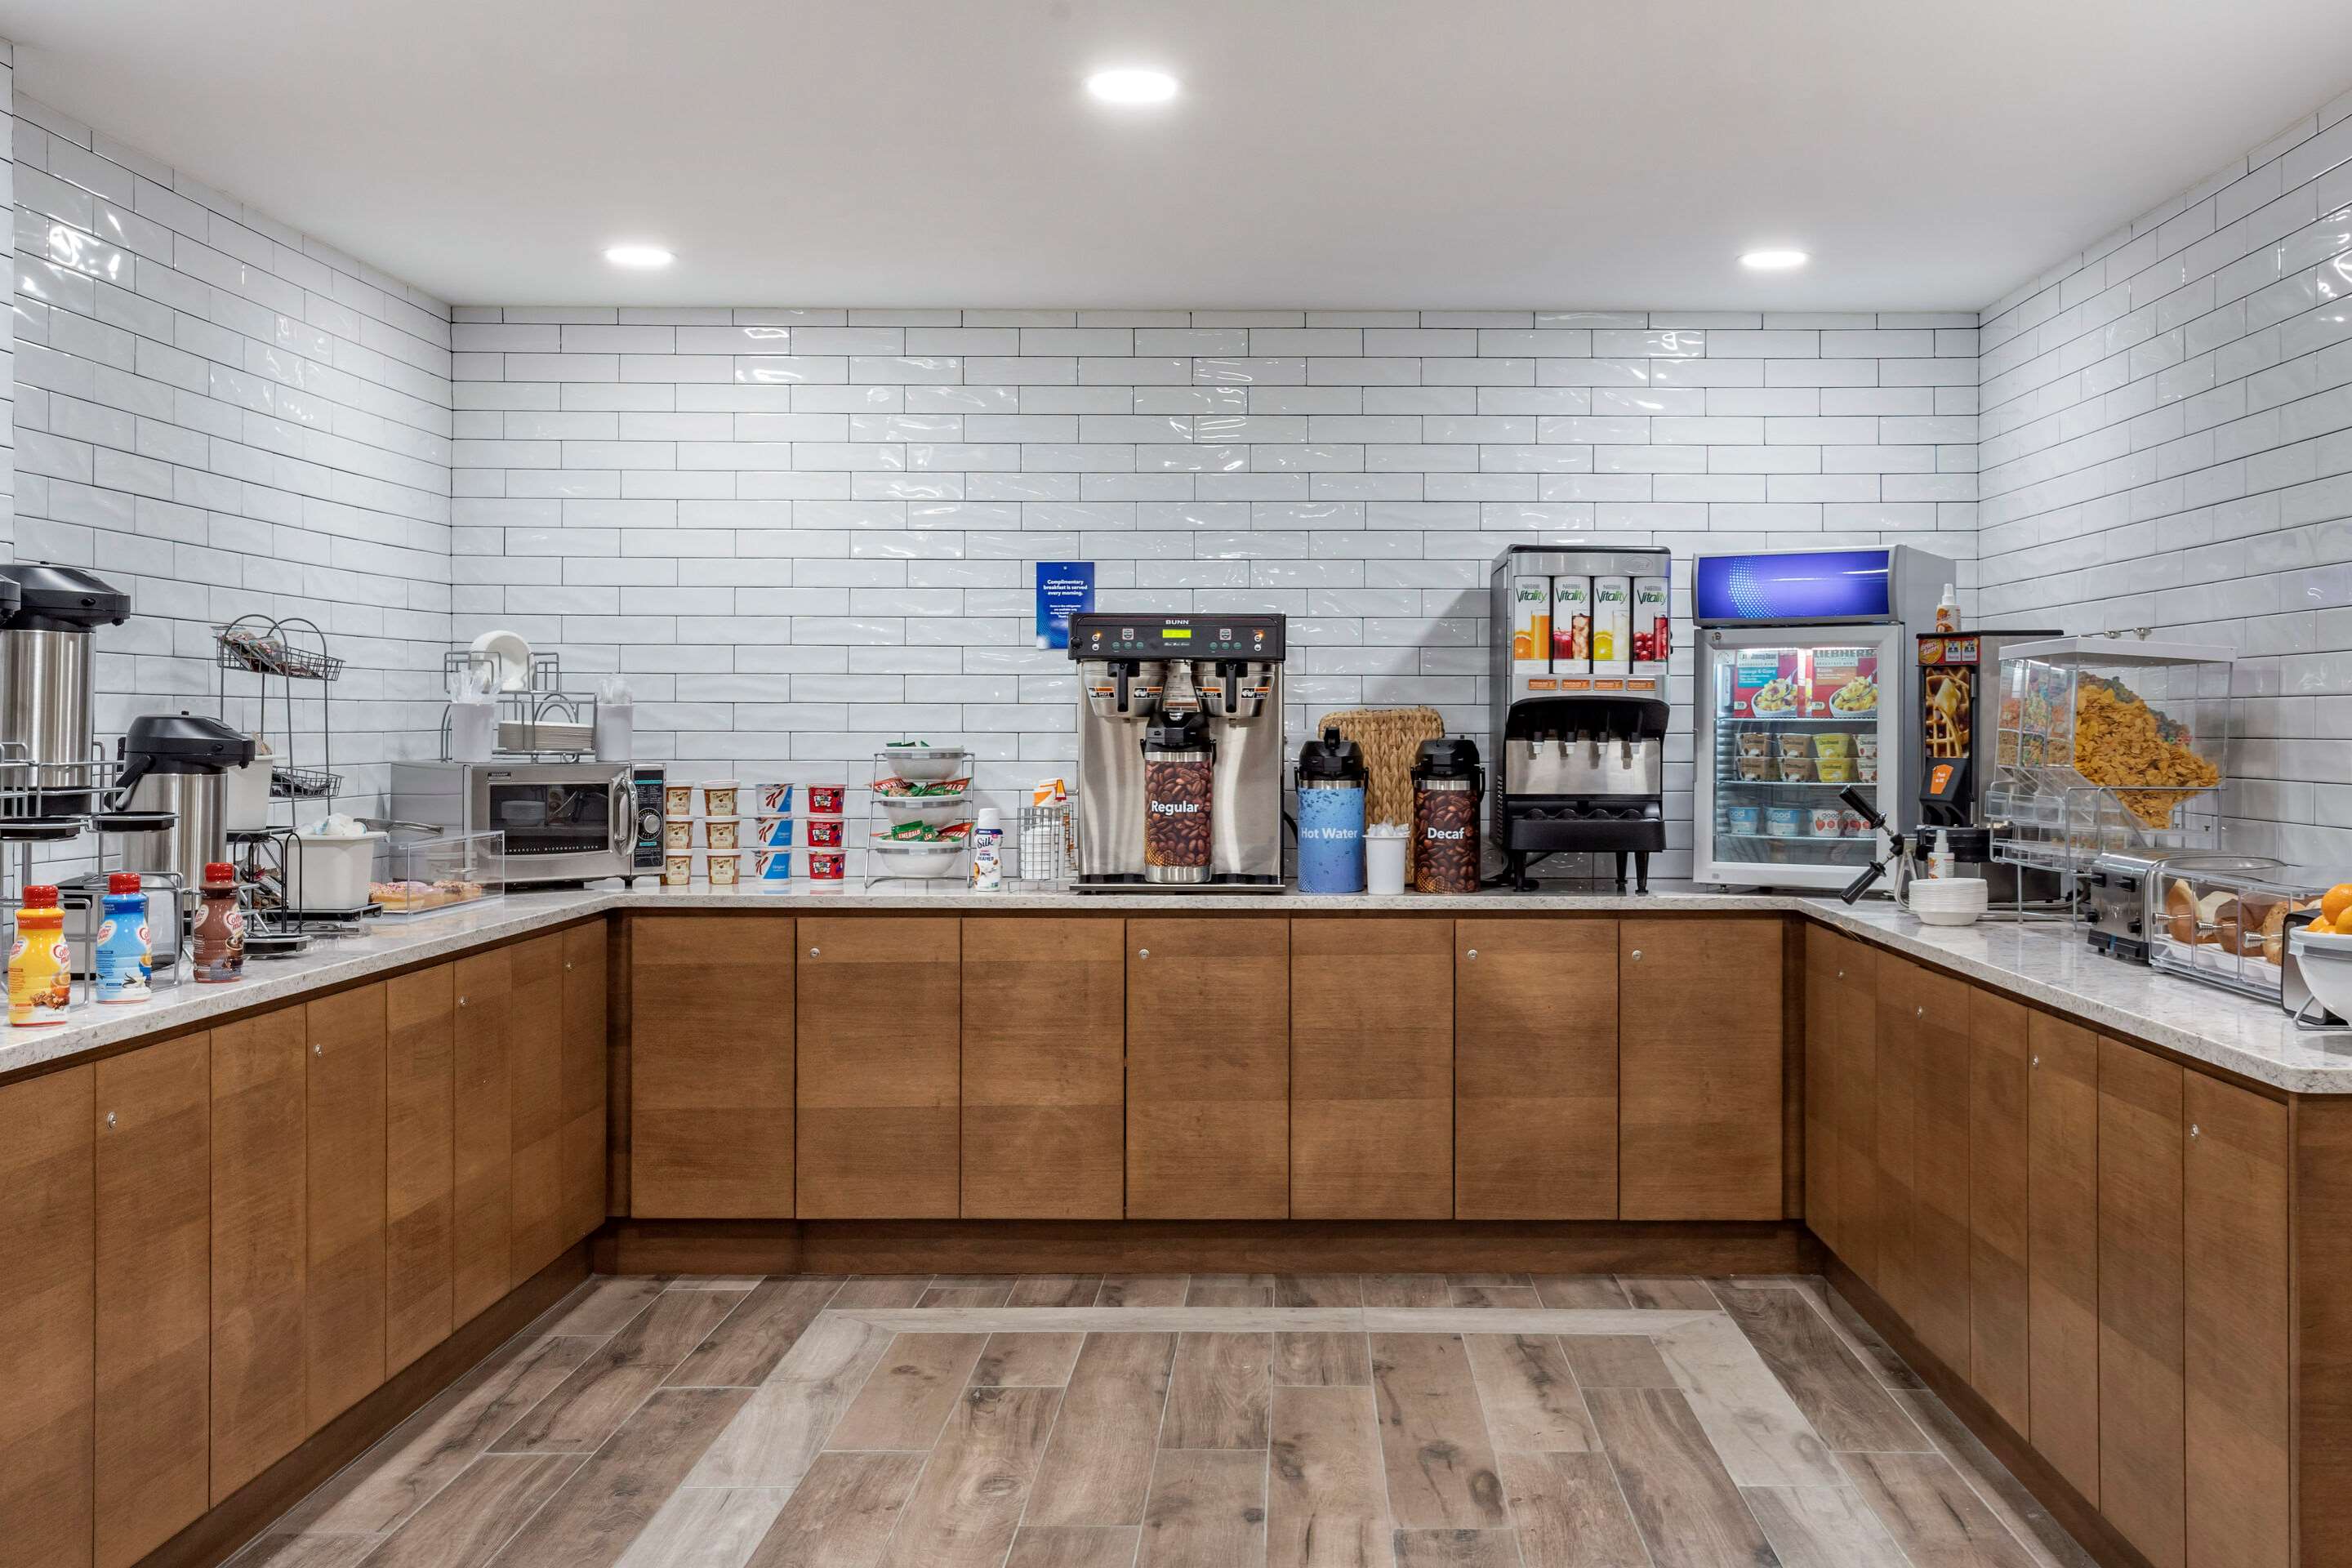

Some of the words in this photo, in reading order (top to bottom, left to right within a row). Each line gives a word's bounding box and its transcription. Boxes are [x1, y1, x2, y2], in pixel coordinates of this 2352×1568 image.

[1516, 588, 1548, 604] Vitality
[1556, 588, 1588, 604] Vitality
[1597, 588, 1628, 604] Vitality
[1637, 589, 1668, 605] Vitality
[1151, 800, 1200, 816] Regular
[898, 830, 921, 839] EMERALD
[1302, 827, 1320, 839] Hot
[1322, 827, 1358, 839] Water
[1428, 826, 1465, 840] Decaf
[978, 836, 994, 849] Silk
